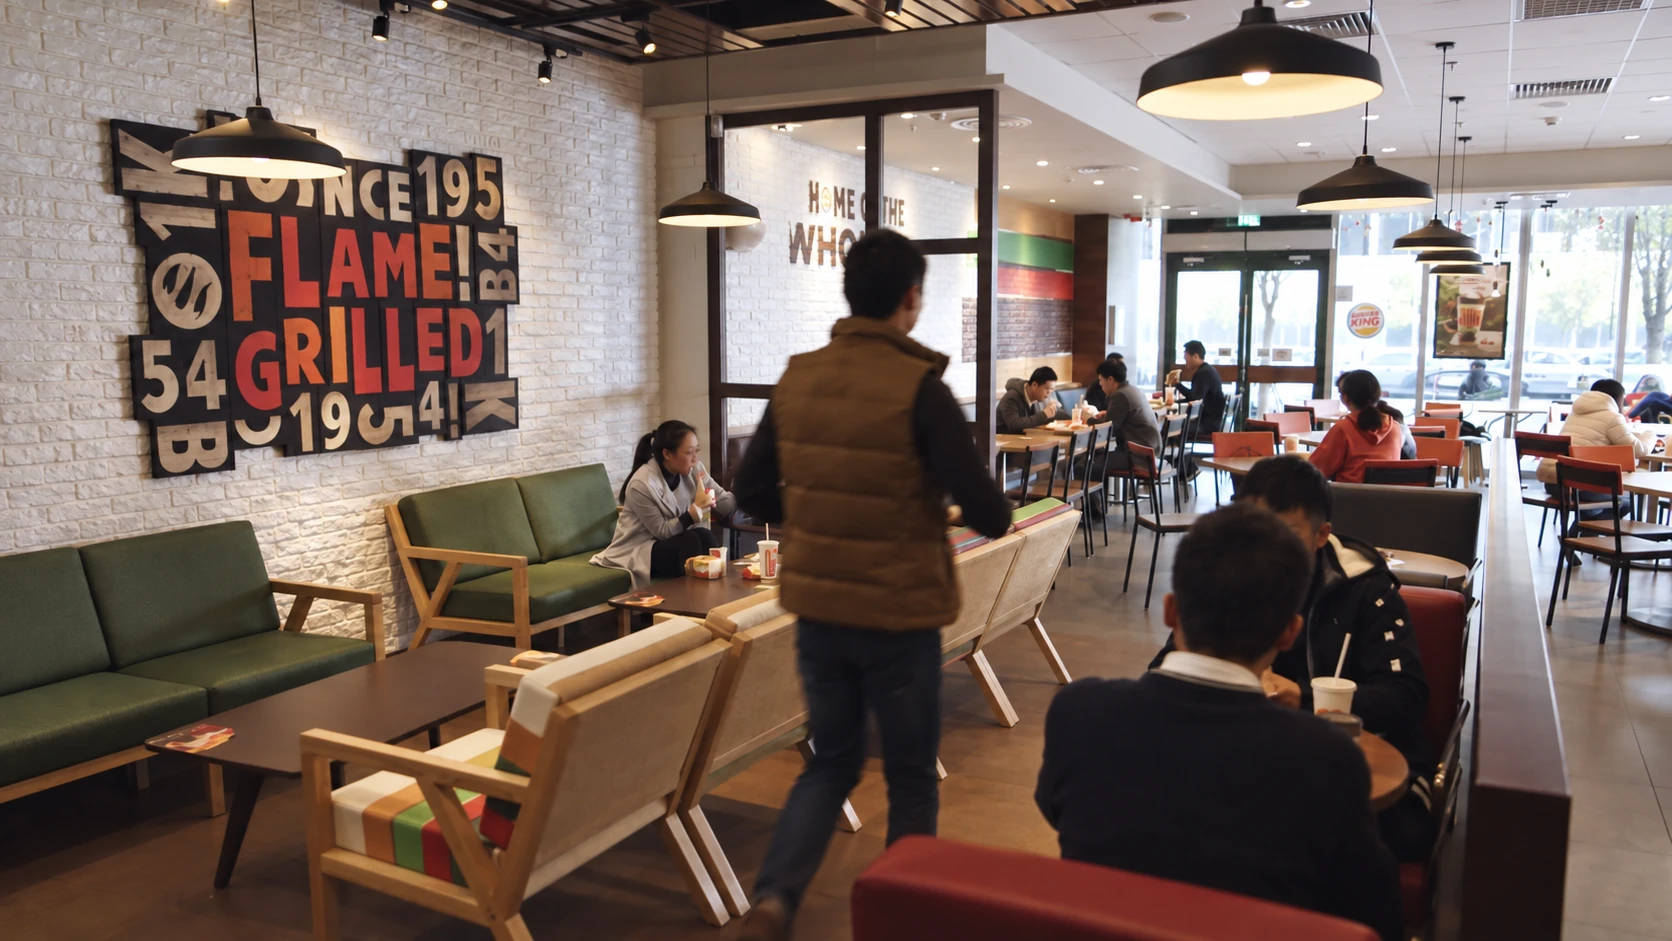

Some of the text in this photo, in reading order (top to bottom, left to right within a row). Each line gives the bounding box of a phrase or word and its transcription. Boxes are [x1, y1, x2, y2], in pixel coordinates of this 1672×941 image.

[418, 156, 502, 221] 195
[1351, 316, 1380, 327] KING
[141, 340, 227, 414] 54
[235, 306, 483, 411] GRILLED
